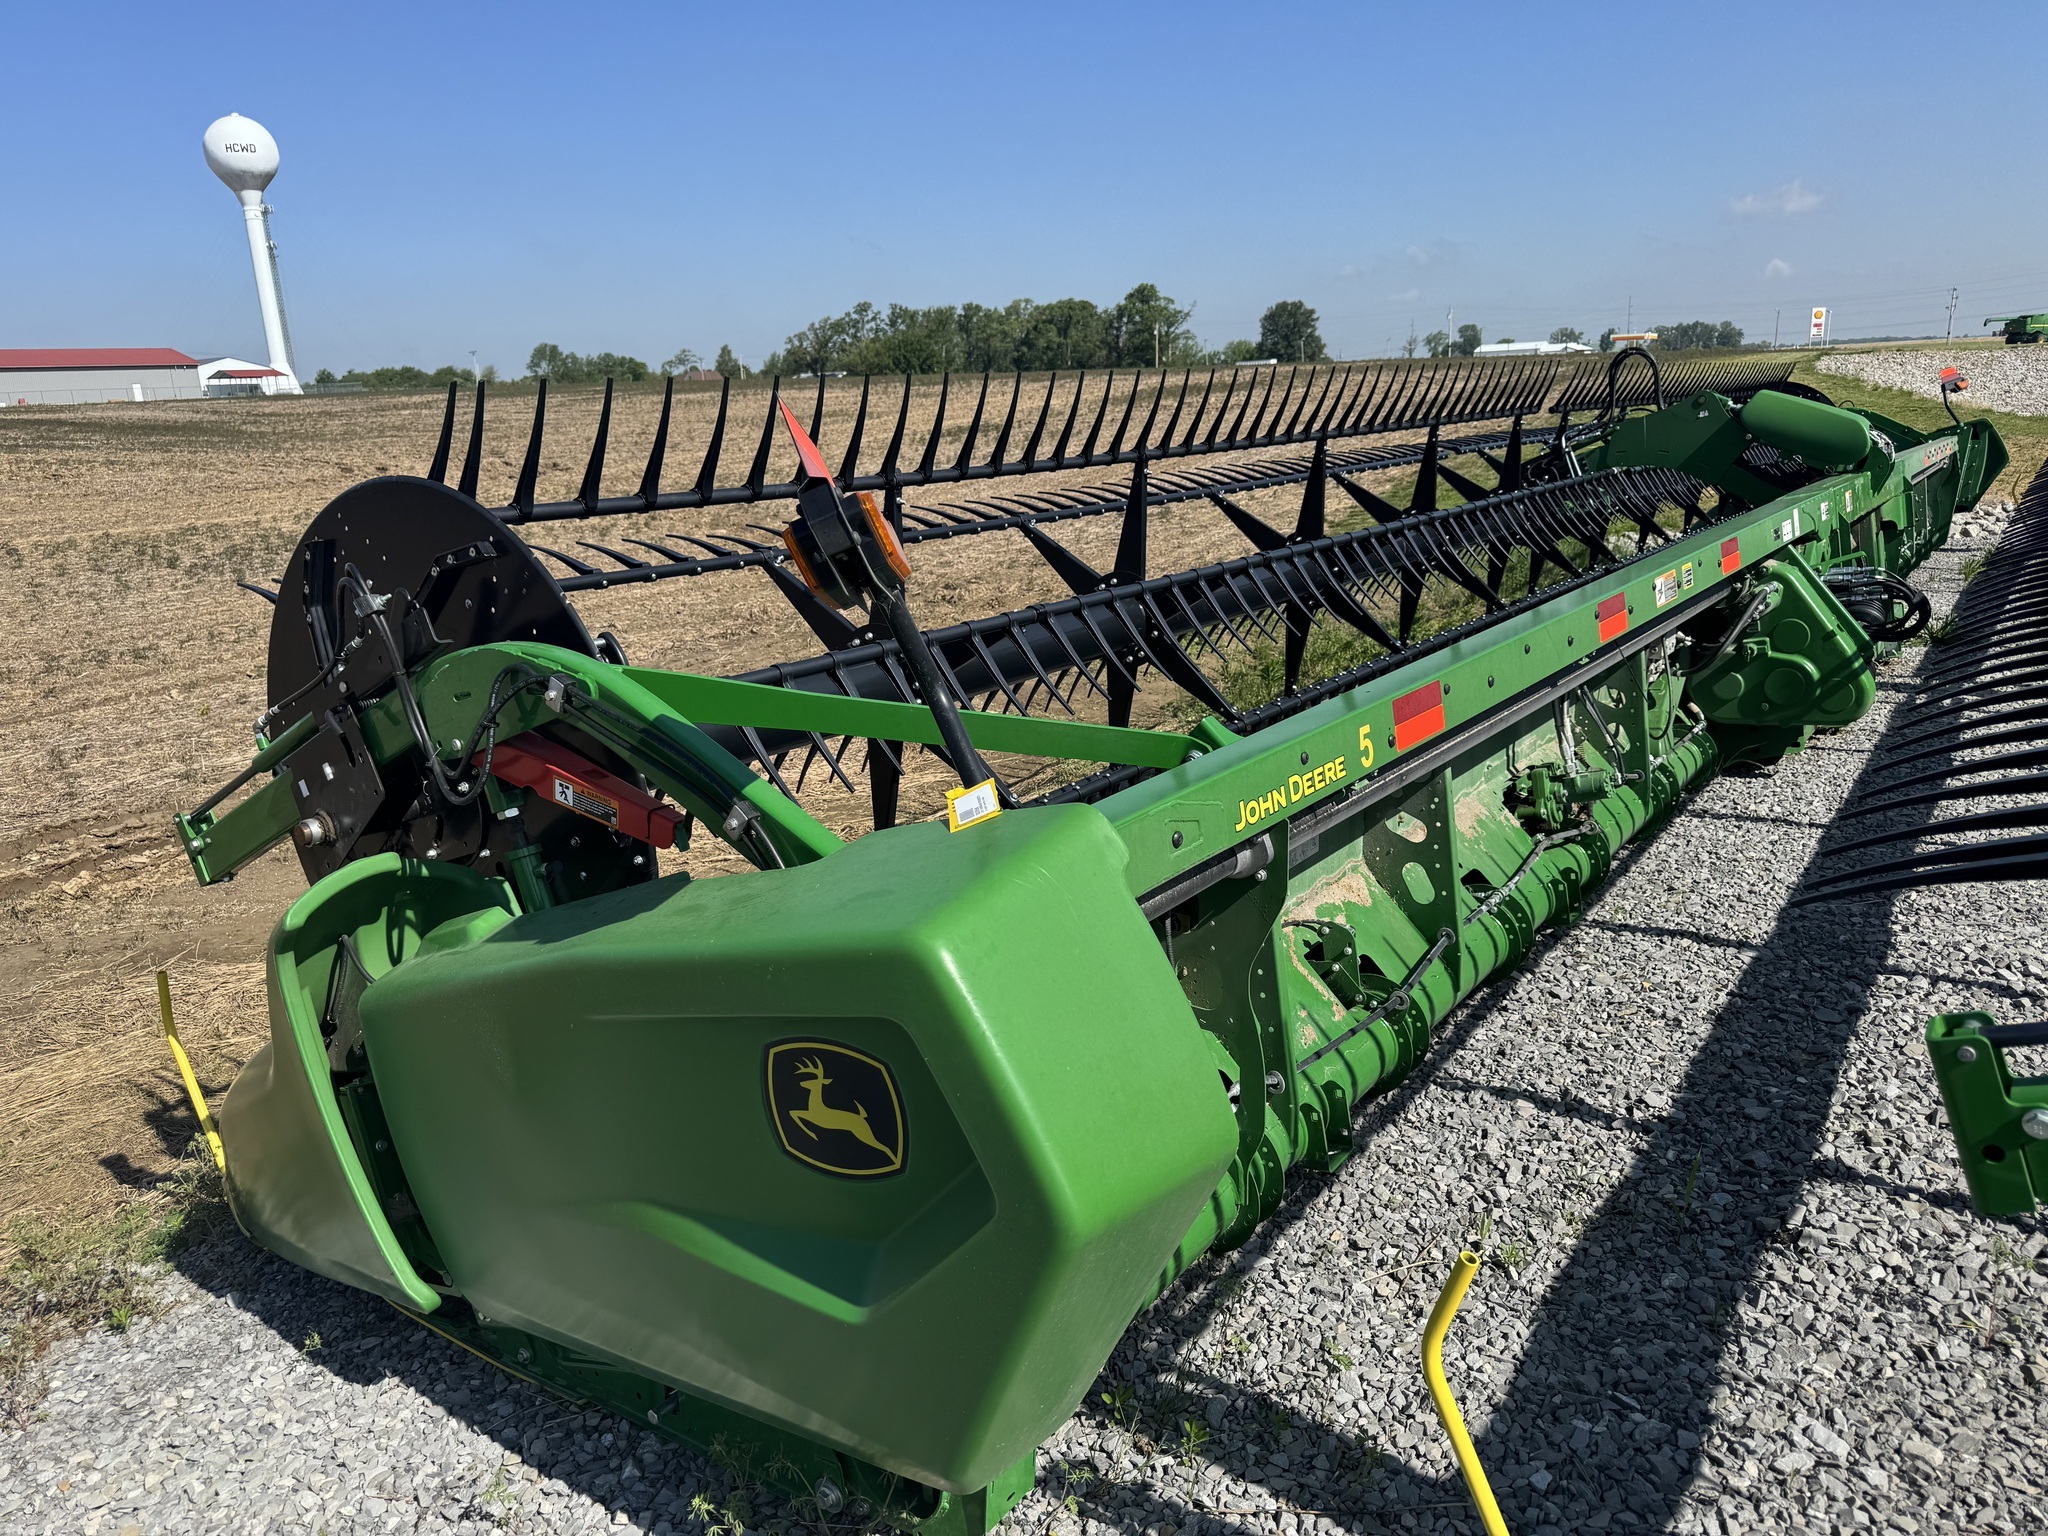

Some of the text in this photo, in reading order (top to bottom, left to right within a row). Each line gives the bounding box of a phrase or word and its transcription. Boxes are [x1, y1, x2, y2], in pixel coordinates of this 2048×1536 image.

[225, 143, 257, 153] HCWD
[1359, 724, 1374, 768] 5
[1235, 754, 1348, 833] JOHN DEERE
